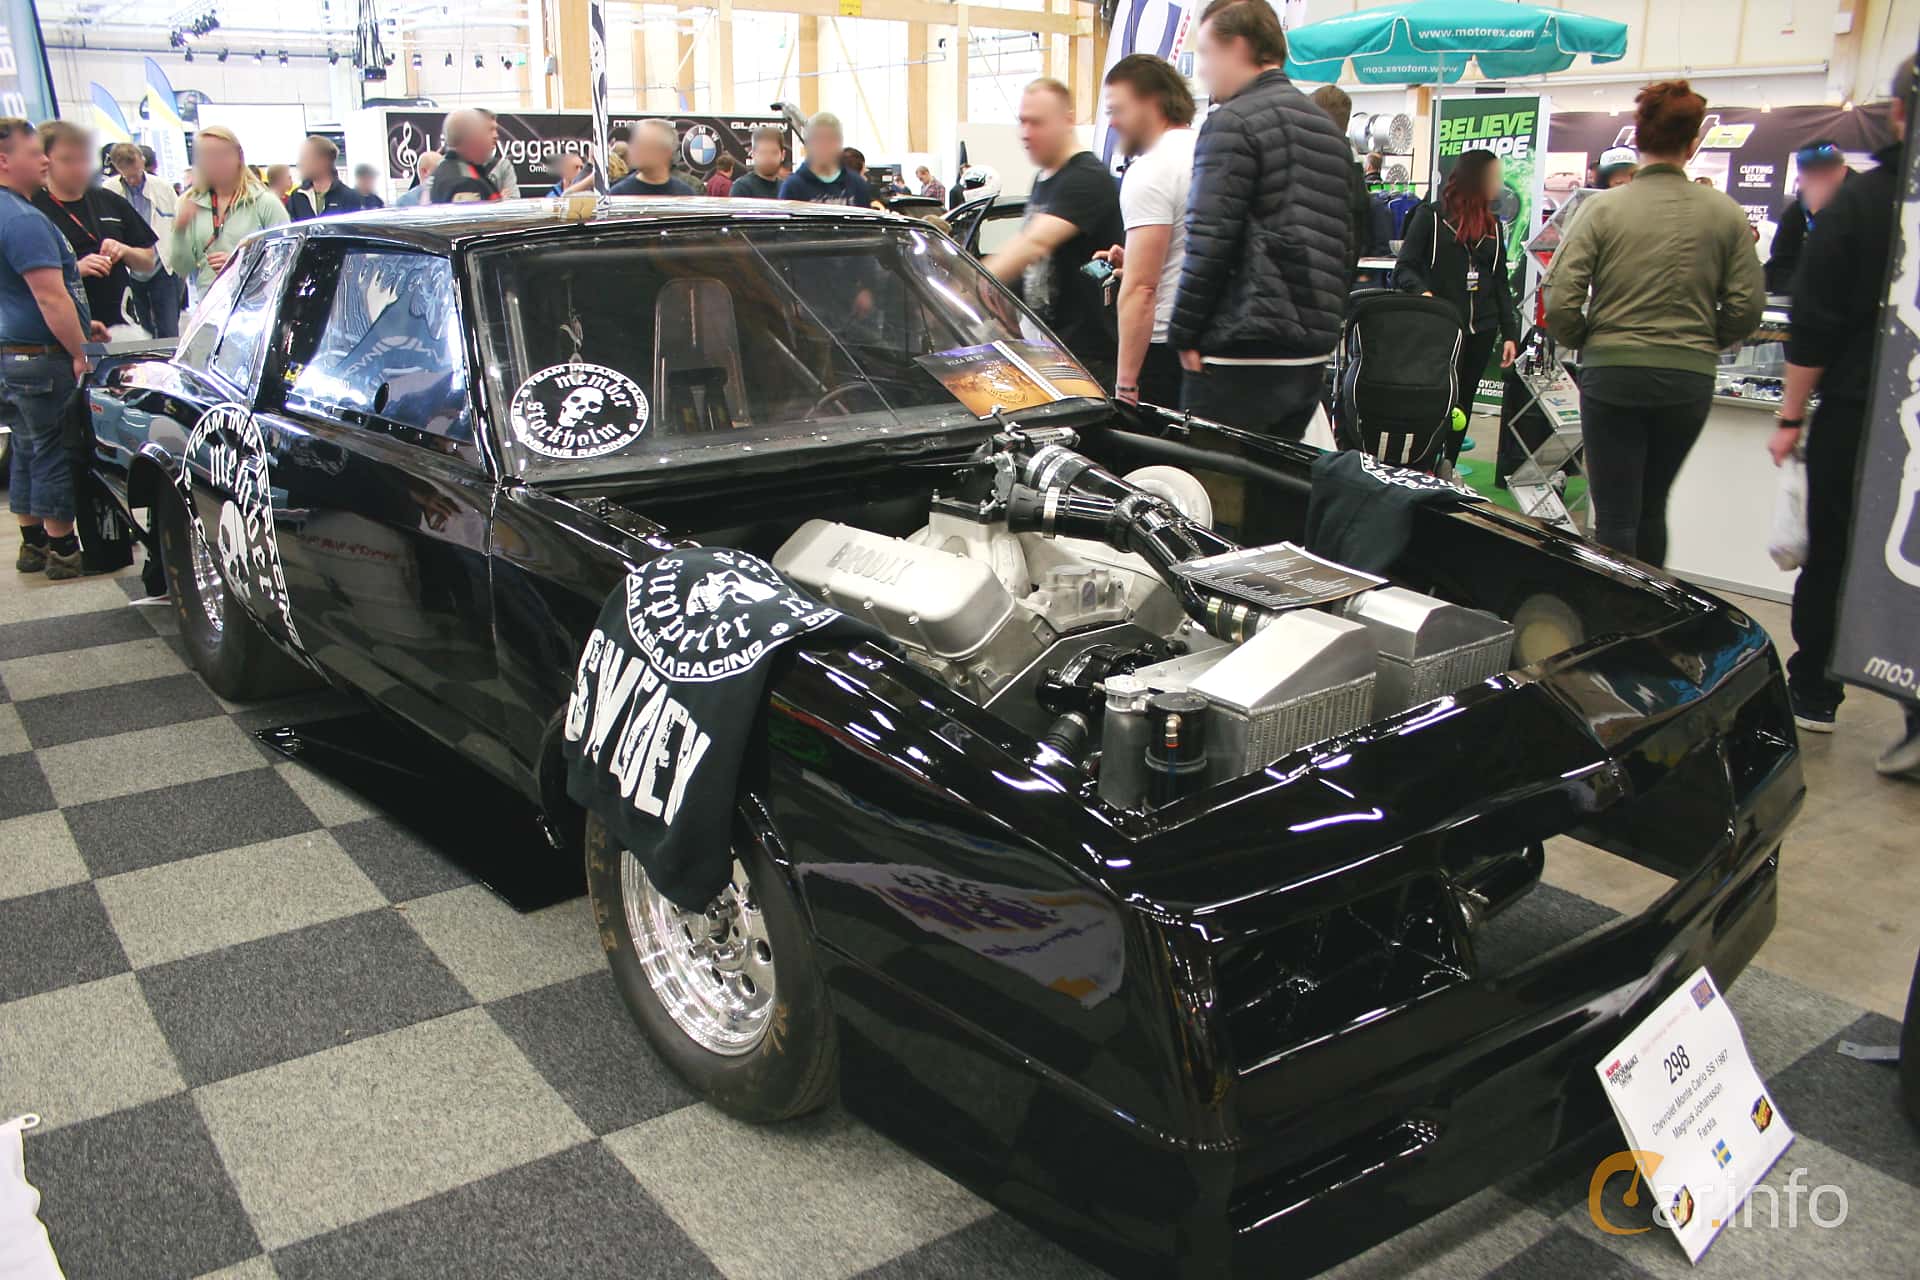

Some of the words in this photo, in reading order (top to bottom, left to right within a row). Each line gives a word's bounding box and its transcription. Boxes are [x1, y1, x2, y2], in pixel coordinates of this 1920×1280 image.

[1419, 27, 1535, 39] www.motorex.com
[1439, 111, 1535, 141] BELIEVE
[1439, 141, 1463, 157] THE
[1739, 165, 1774, 175] CUTTING
[569, 365, 626, 382] INSANE
[623, 381, 648, 421] RACING
[188, 411, 224, 459] TEAM
[523, 433, 573, 456] NSANE
[577, 434, 632, 456] RACING
[676, 640, 763, 677] RACING
[1664, 1044, 1690, 1084] 298
[1652, 1098, 1677, 1136] Chevrolet
[1674, 1086, 1693, 1115] Monte
[1691, 1072, 1707, 1097] Carlo
[1707, 1060, 1718, 1078] SS
[1715, 1048, 1729, 1067] 1987
[1672, 1110, 1696, 1139] Magnus
[1694, 1082, 1724, 1117] Johansson
[1697, 1115, 1718, 1138] Farsta
